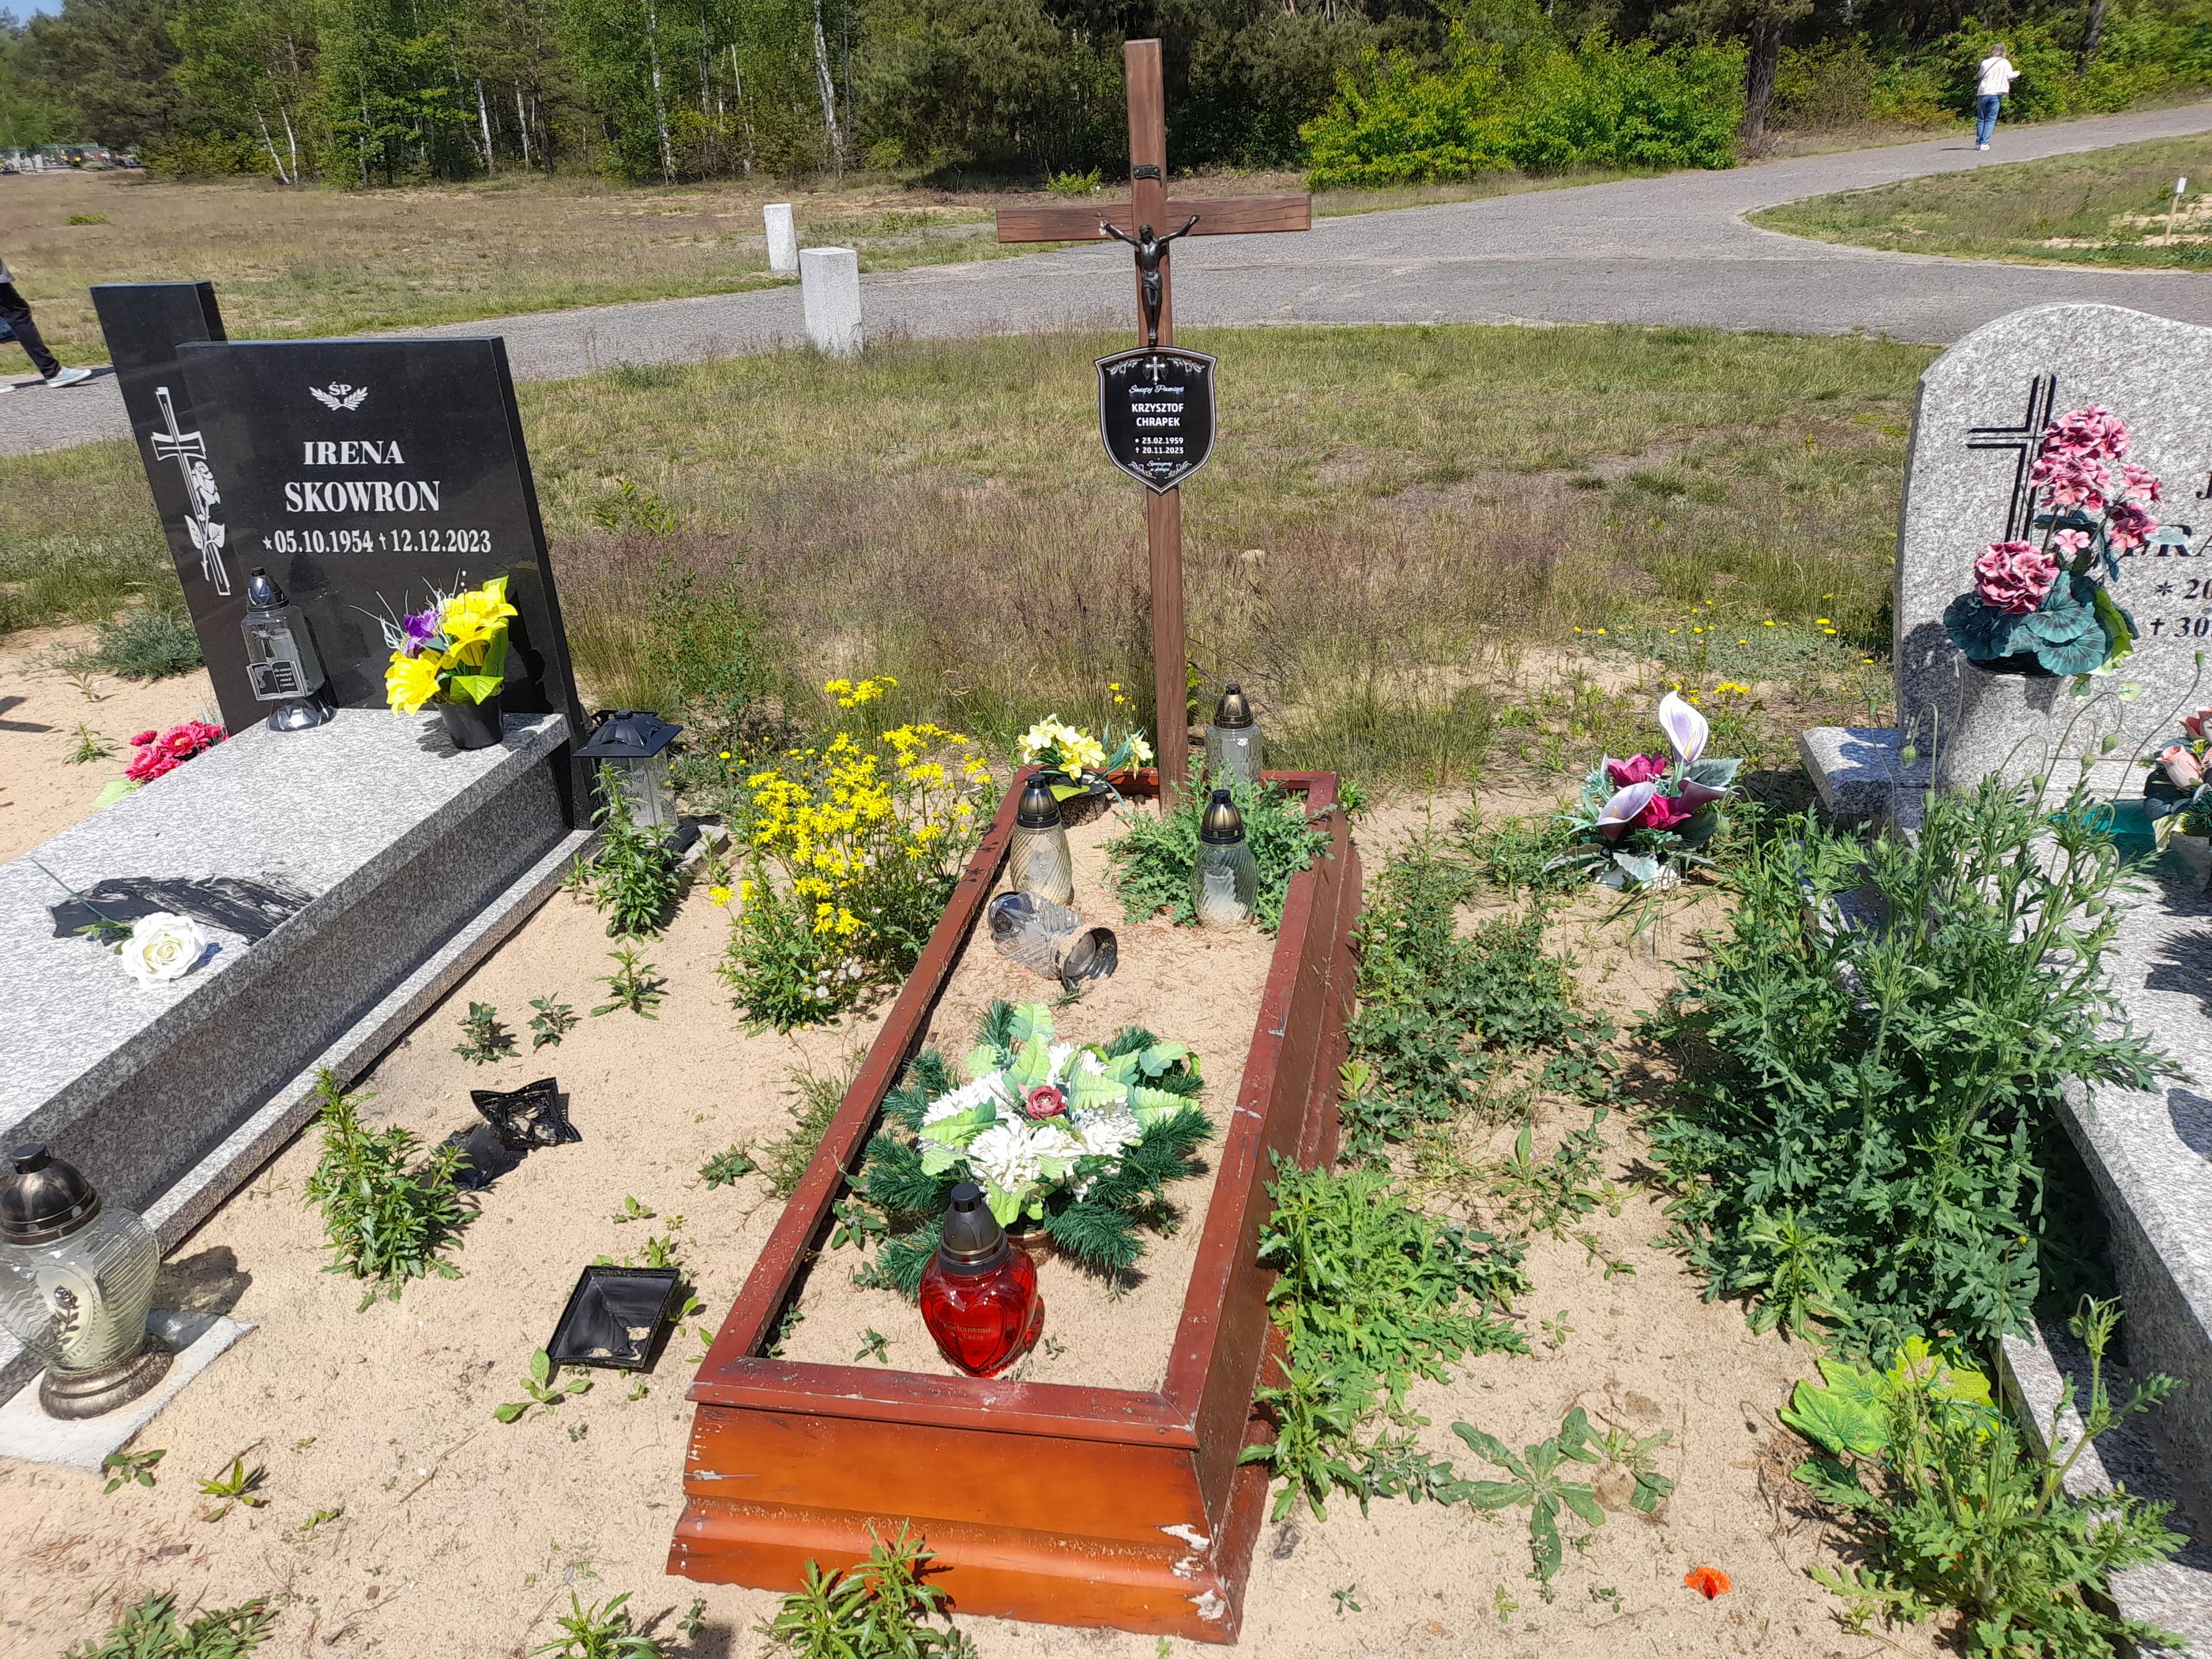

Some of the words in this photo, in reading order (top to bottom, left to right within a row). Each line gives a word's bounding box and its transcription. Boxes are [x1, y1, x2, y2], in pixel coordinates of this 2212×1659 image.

[328, 381, 352, 395] ŚP
[1131, 403, 1184, 412] KRZYSZTOF
[1136, 417, 1180, 427] CHRAPEK
[303, 440, 405, 465] IRENA
[284, 480, 441, 513] SKOWRON
[274, 529, 374, 553] 05.10.1954
[391, 529, 491, 553] 12.12.2023
